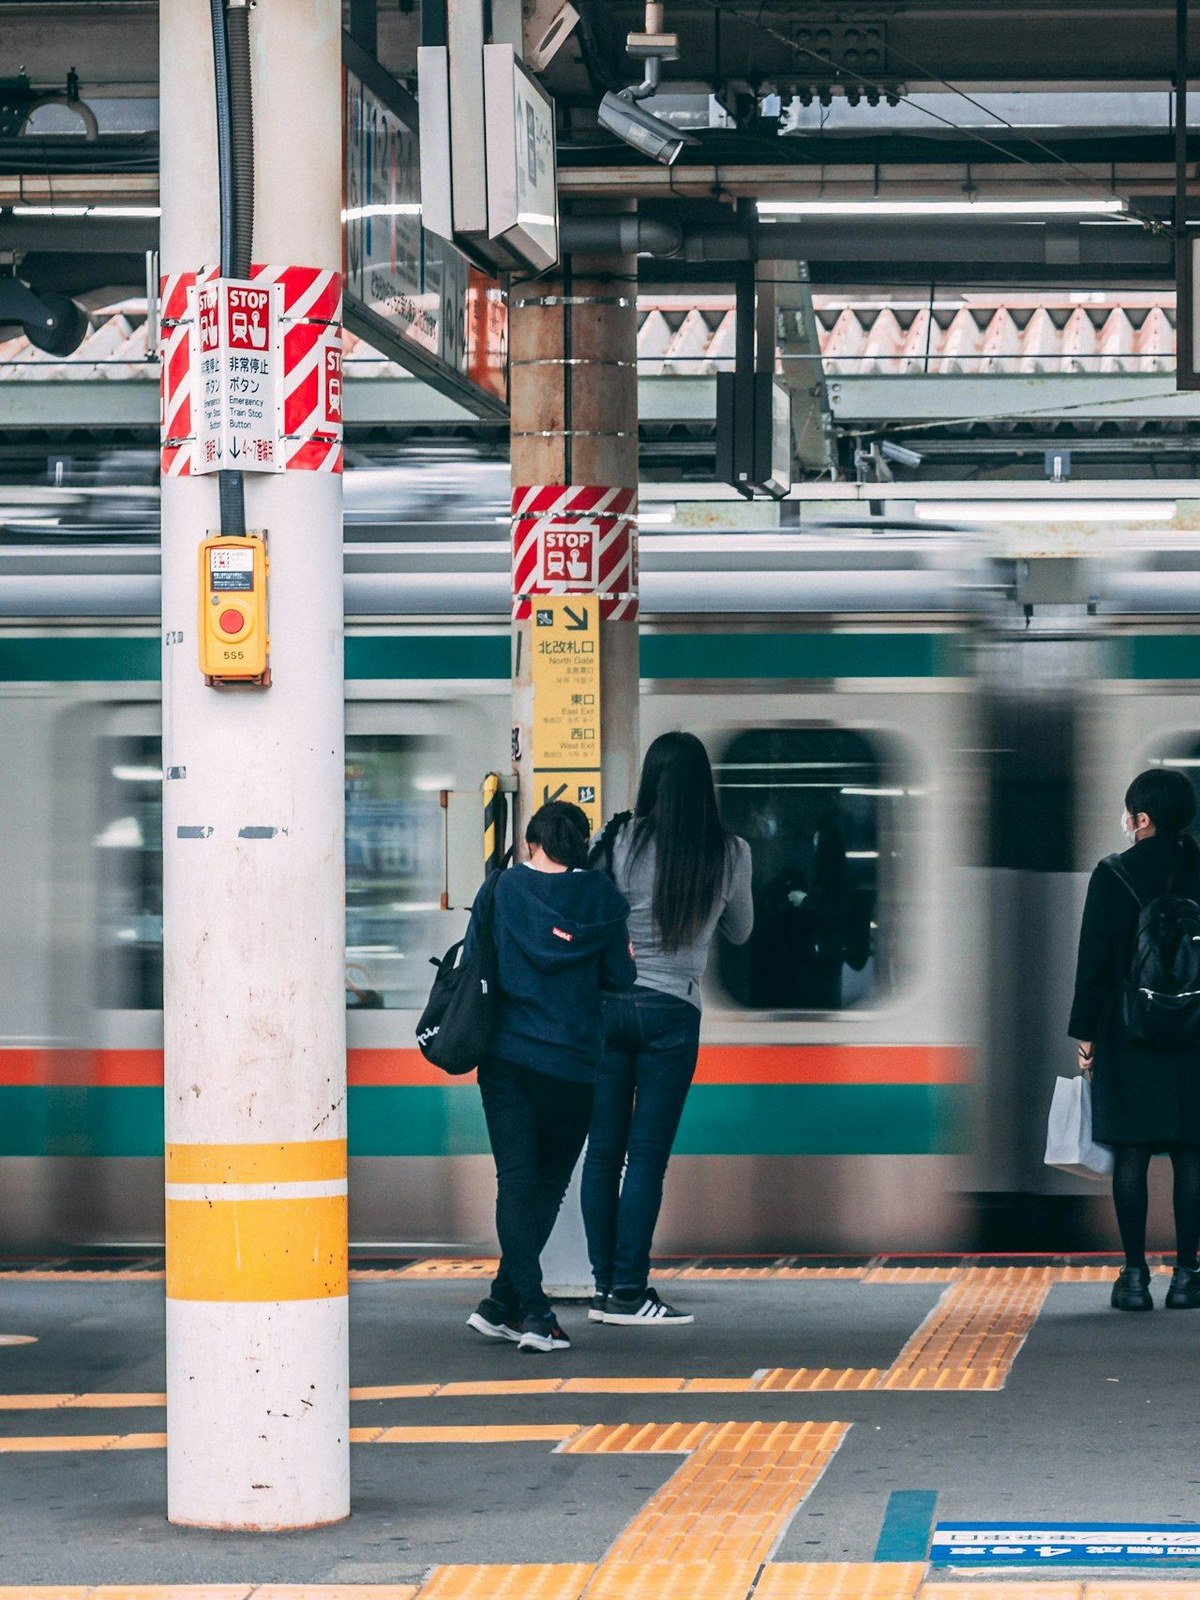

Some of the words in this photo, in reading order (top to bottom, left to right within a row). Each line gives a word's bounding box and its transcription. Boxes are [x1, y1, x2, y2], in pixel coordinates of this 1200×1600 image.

[199, 291, 218, 311] STOP
[229, 289, 268, 310] STOP
[229, 356, 269, 375] 非常停止
[327, 350, 341, 372] ST
[230, 376, 260, 394] ボタン
[229, 395, 264, 408] Emergency
[230, 407, 246, 417] Train
[248, 408, 263, 419] Stop
[229, 419, 252, 429] Button
[546, 533, 590, 548] STOP
[538, 640, 594, 654] 北改札口
[549, 656, 572, 665] North
[574, 656, 594, 665] Gate
[571, 694, 595, 705] 東口
[571, 728, 595, 740] 西口
[949, 1545, 1073, 1559] 4号車
